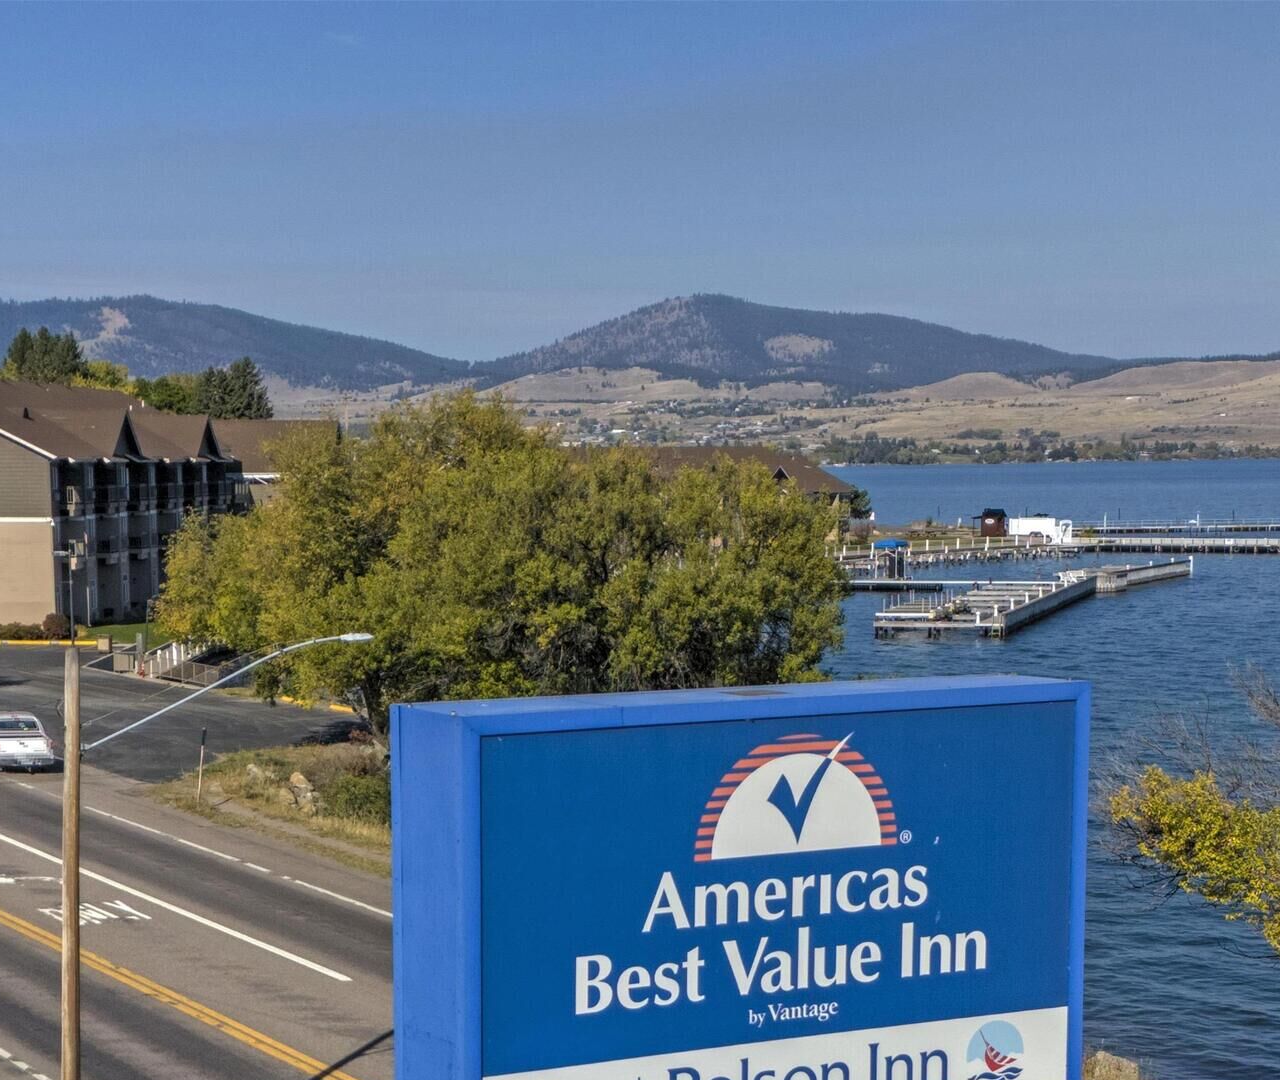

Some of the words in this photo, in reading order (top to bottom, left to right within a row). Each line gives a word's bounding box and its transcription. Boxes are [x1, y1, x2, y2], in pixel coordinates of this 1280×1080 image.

[641, 864, 929, 933] Americas
[574, 945, 706, 1016] Best
[722, 926, 882, 997] Value
[901, 921, 988, 979] Inn
[748, 1009, 767, 1028] by
[767, 1001, 839, 1022] Vantage
